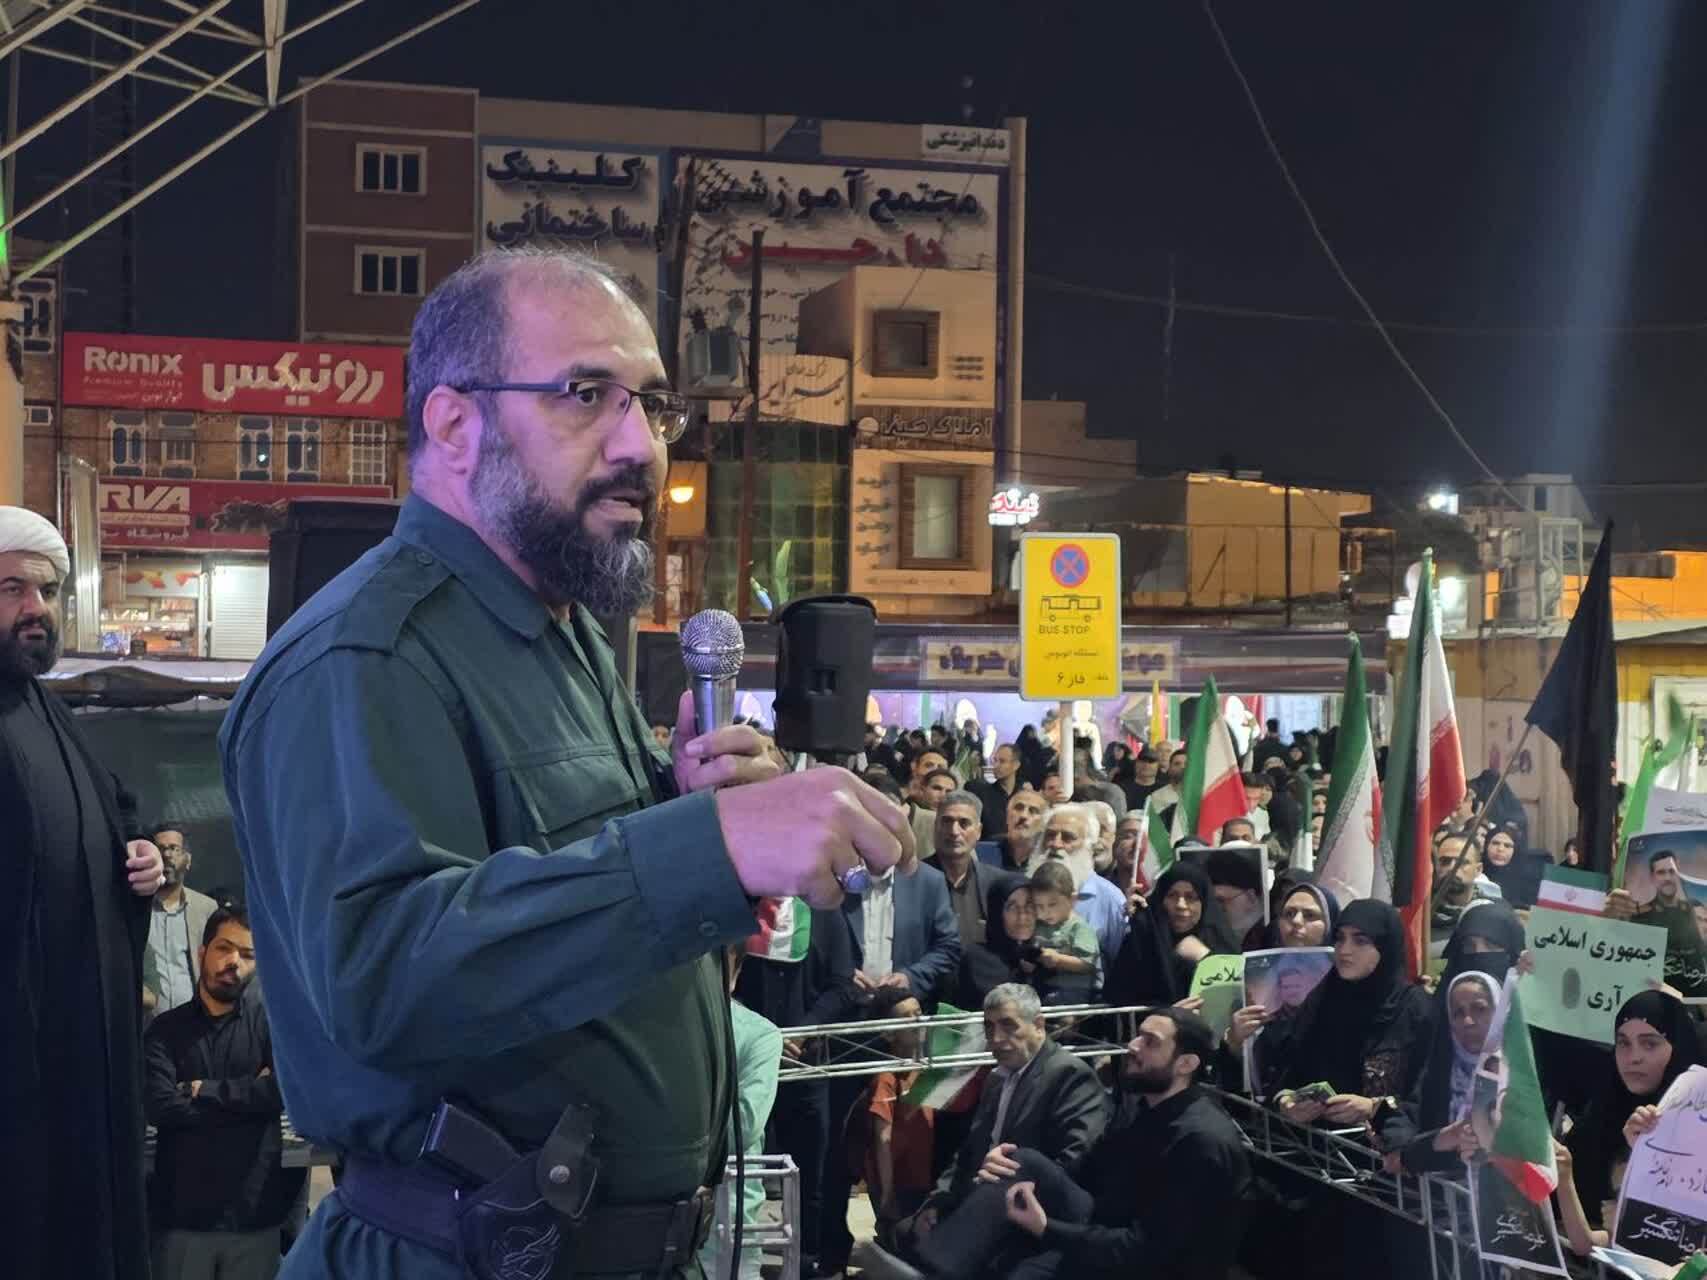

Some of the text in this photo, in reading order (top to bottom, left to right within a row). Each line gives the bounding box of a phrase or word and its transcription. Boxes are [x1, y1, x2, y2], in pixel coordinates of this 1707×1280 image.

[486, 150, 642, 189] کلینیک
[869, 182, 978, 223] مجتمع
[202, 352, 384, 406] رونیکس
[934, 415, 993, 439] املاک
[1039, 624, 1090, 634] BUS STOP
[1534, 926, 1587, 949] اسلامی
[1589, 937, 1656, 967] جمهوری
[1587, 985, 1623, 1012] آری
